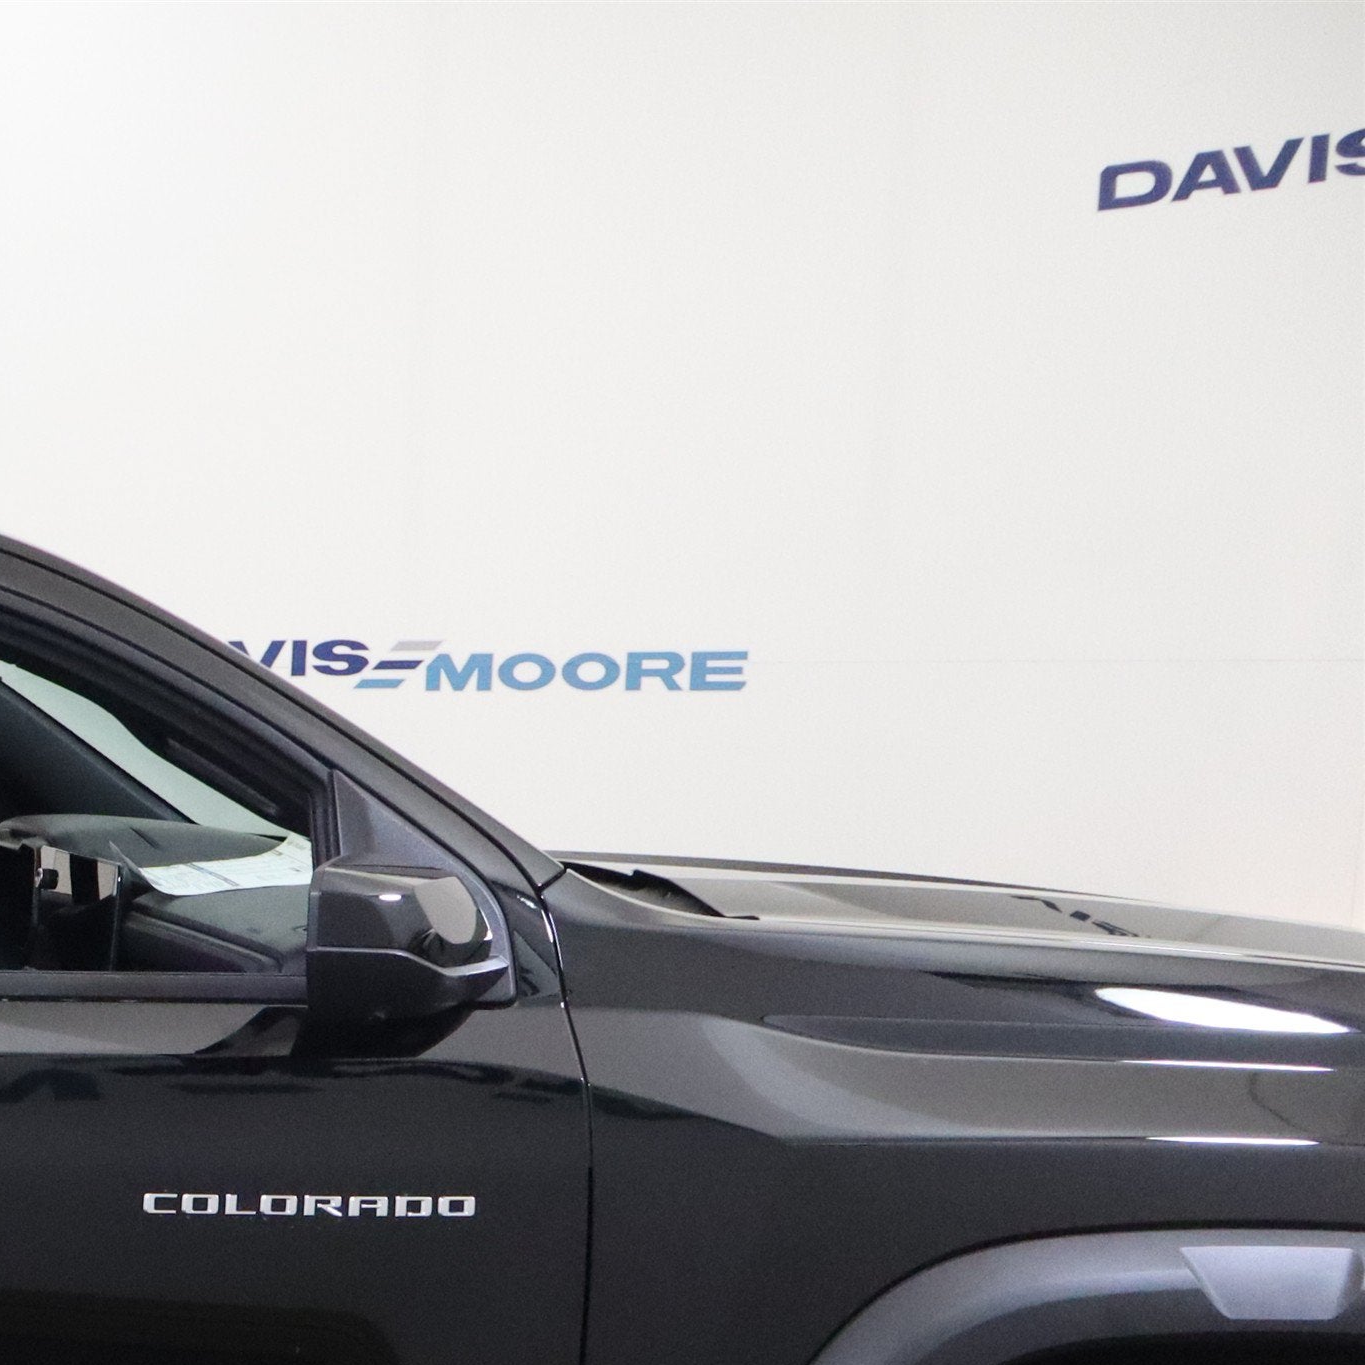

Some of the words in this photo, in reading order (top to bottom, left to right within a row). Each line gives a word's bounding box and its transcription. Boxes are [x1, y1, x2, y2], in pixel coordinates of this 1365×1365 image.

[229, 638, 370, 677] VIS
[424, 649, 749, 691] MOORE
[142, 1192, 477, 1217] COLORADO
